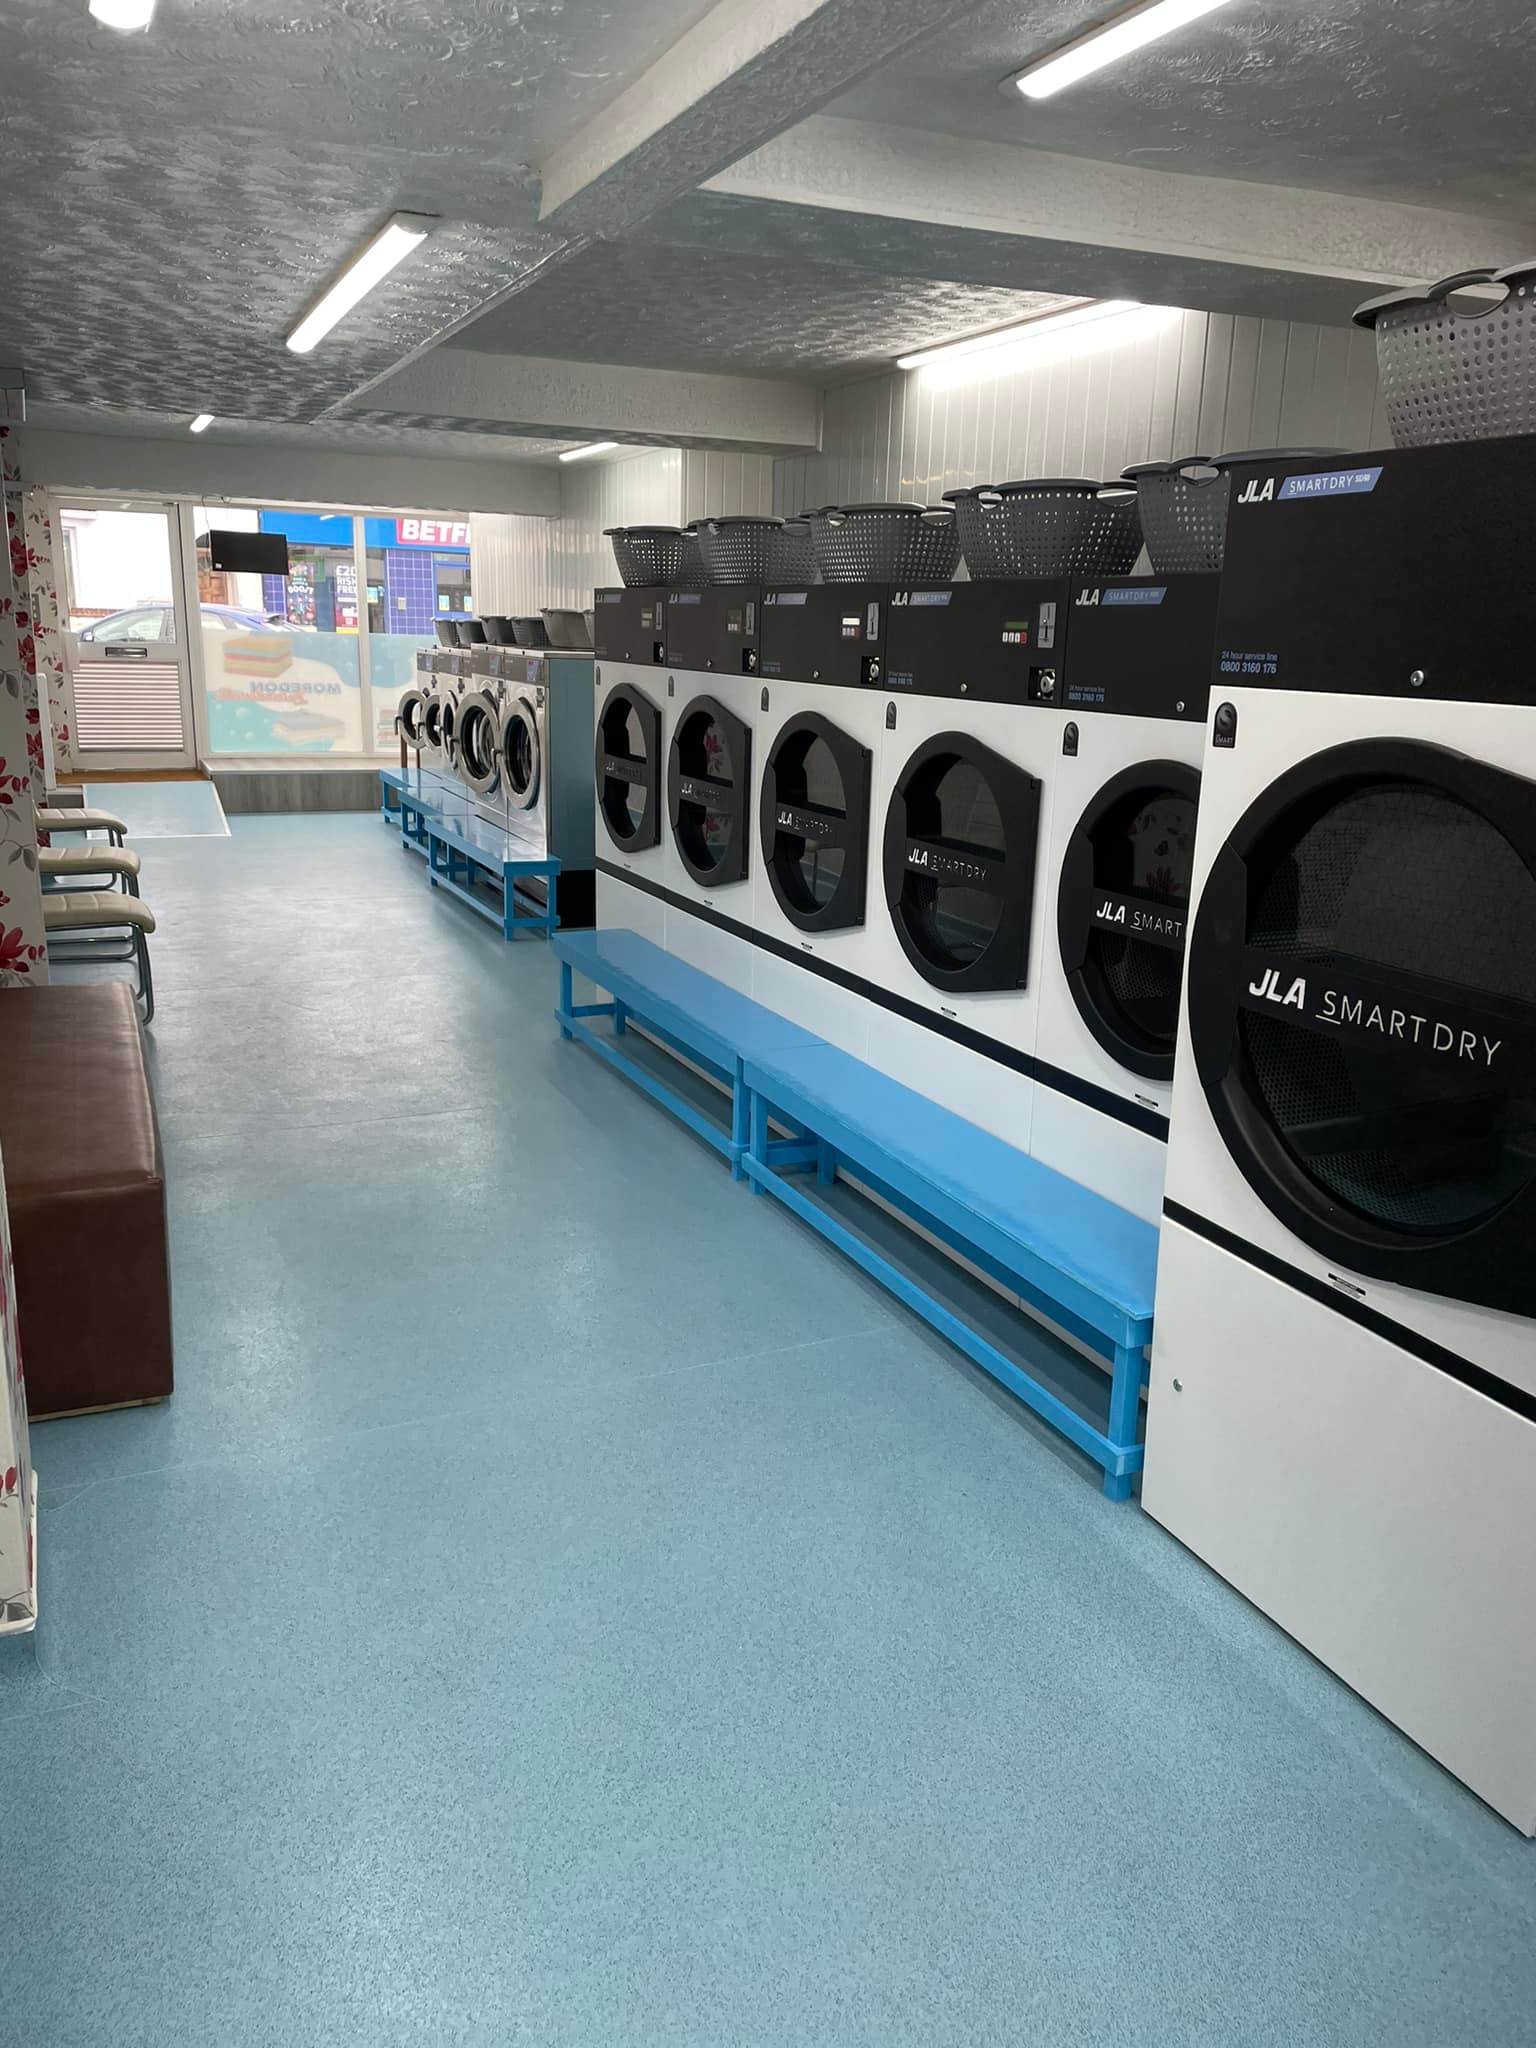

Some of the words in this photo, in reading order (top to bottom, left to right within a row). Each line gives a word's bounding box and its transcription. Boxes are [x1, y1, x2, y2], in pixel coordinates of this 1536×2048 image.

[1238, 478, 1275, 503] JLA
[1287, 474, 1353, 495] SMARTDRY
[402, 518, 471, 543] BETF
[891, 591, 908, 606] JLA
[1075, 589, 1100, 606] JLA
[1220, 661, 1240, 672] 0800
[1241, 662, 1261, 673] 3160
[778, 811, 792, 826] JLA
[908, 847, 928, 866] JLA
[1096, 901, 1126, 923] JLA
[1249, 968, 1307, 1009] JLA
[1314, 990, 1502, 1066] SMARTDRY
